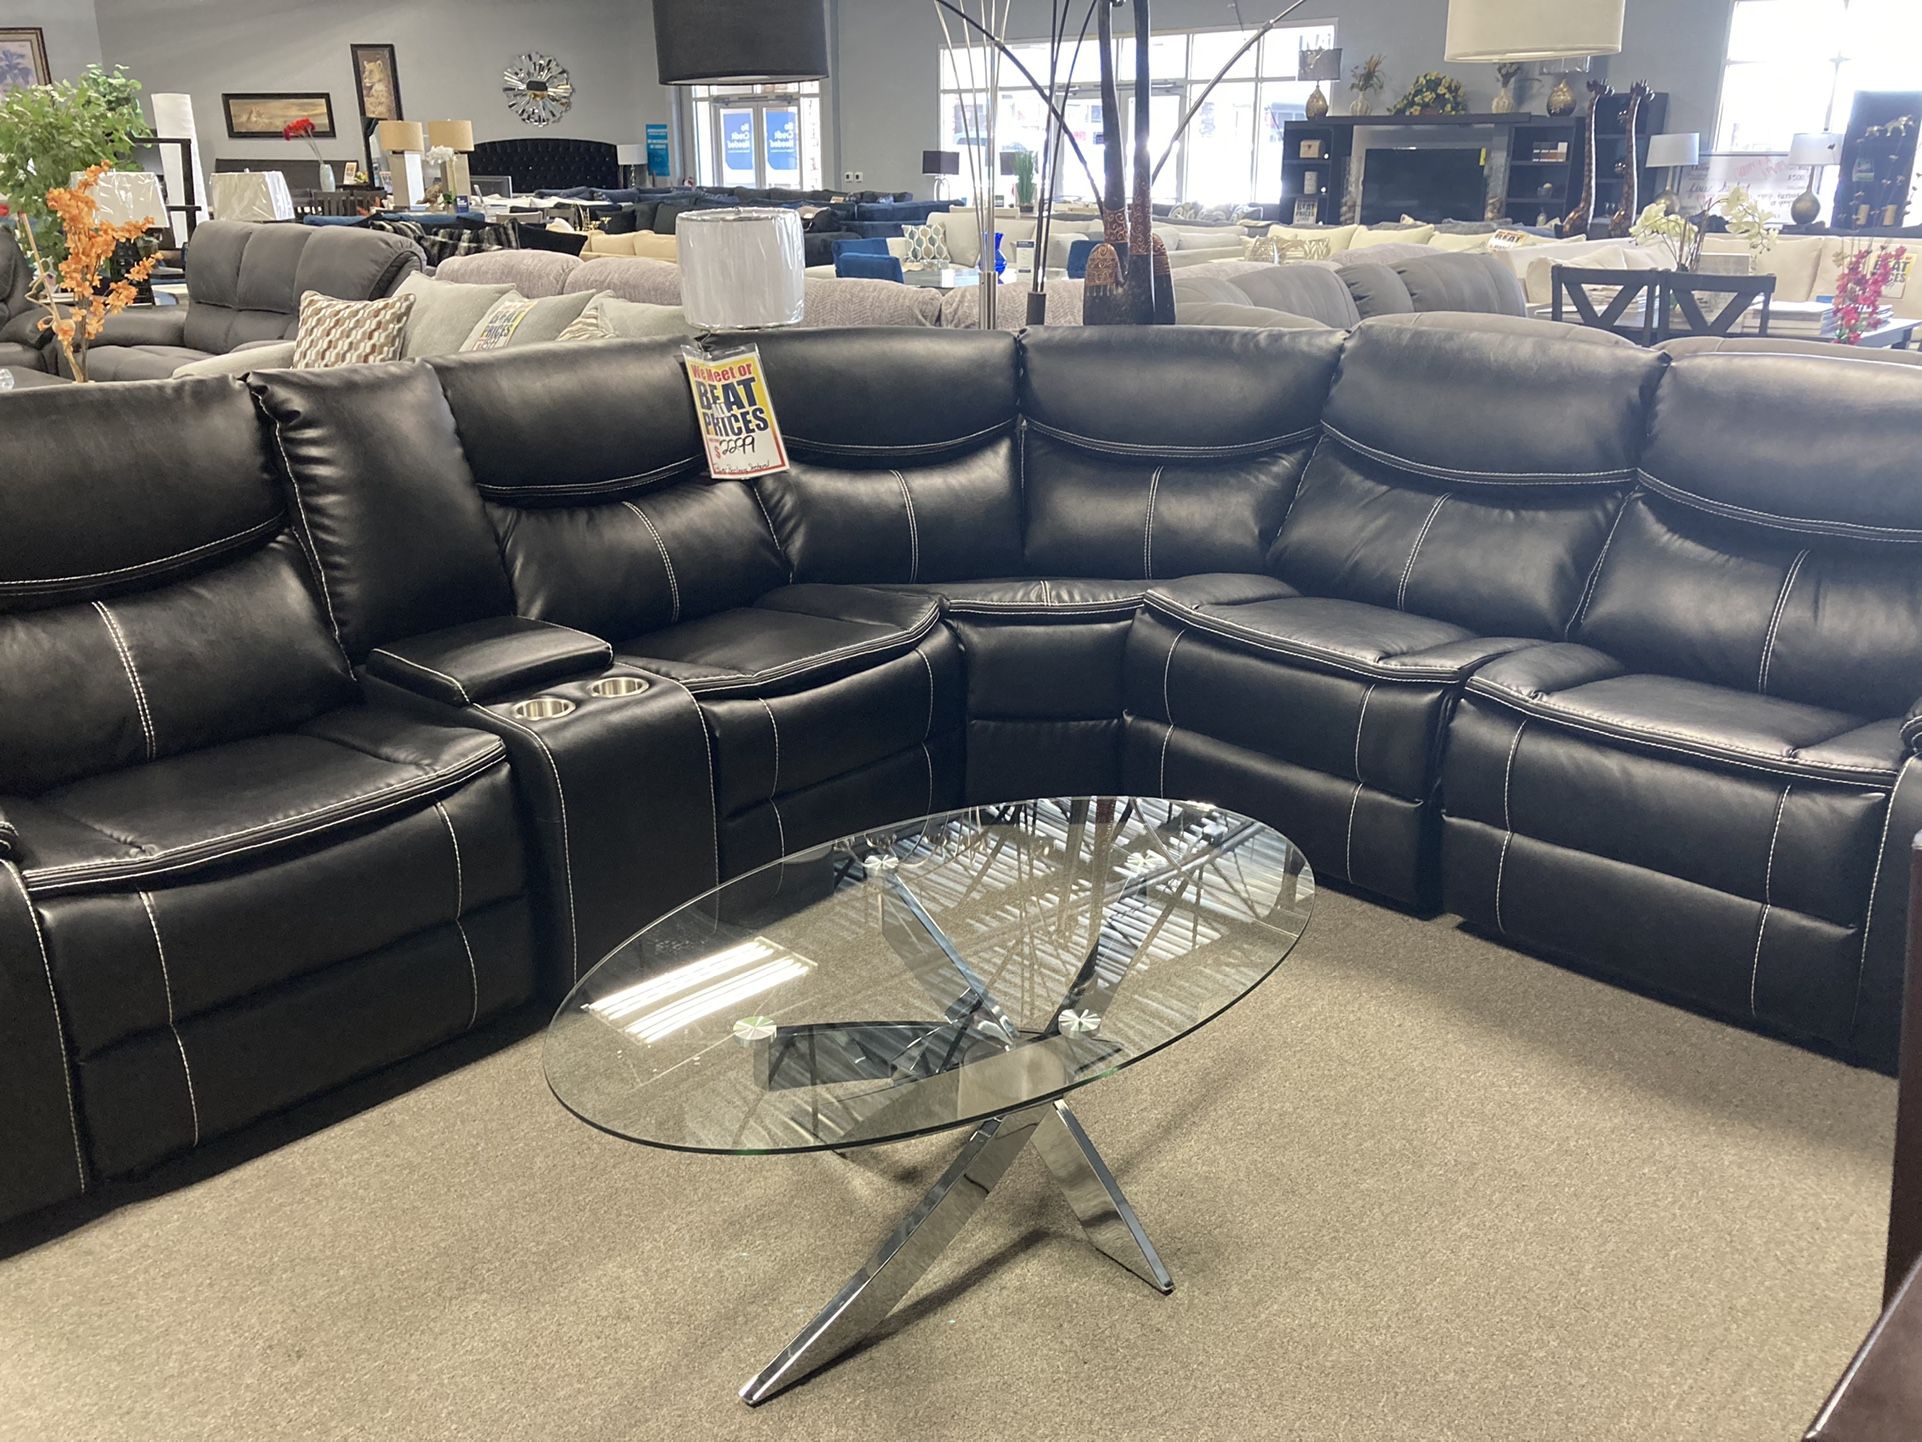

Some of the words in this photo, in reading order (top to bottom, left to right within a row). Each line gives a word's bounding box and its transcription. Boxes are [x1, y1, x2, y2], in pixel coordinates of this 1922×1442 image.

[691, 364, 706, 379] We
[705, 366, 737, 383] Meet
[737, 362, 753, 377] or
[695, 376, 758, 413] BEAT
[702, 406, 769, 437] PRICES
